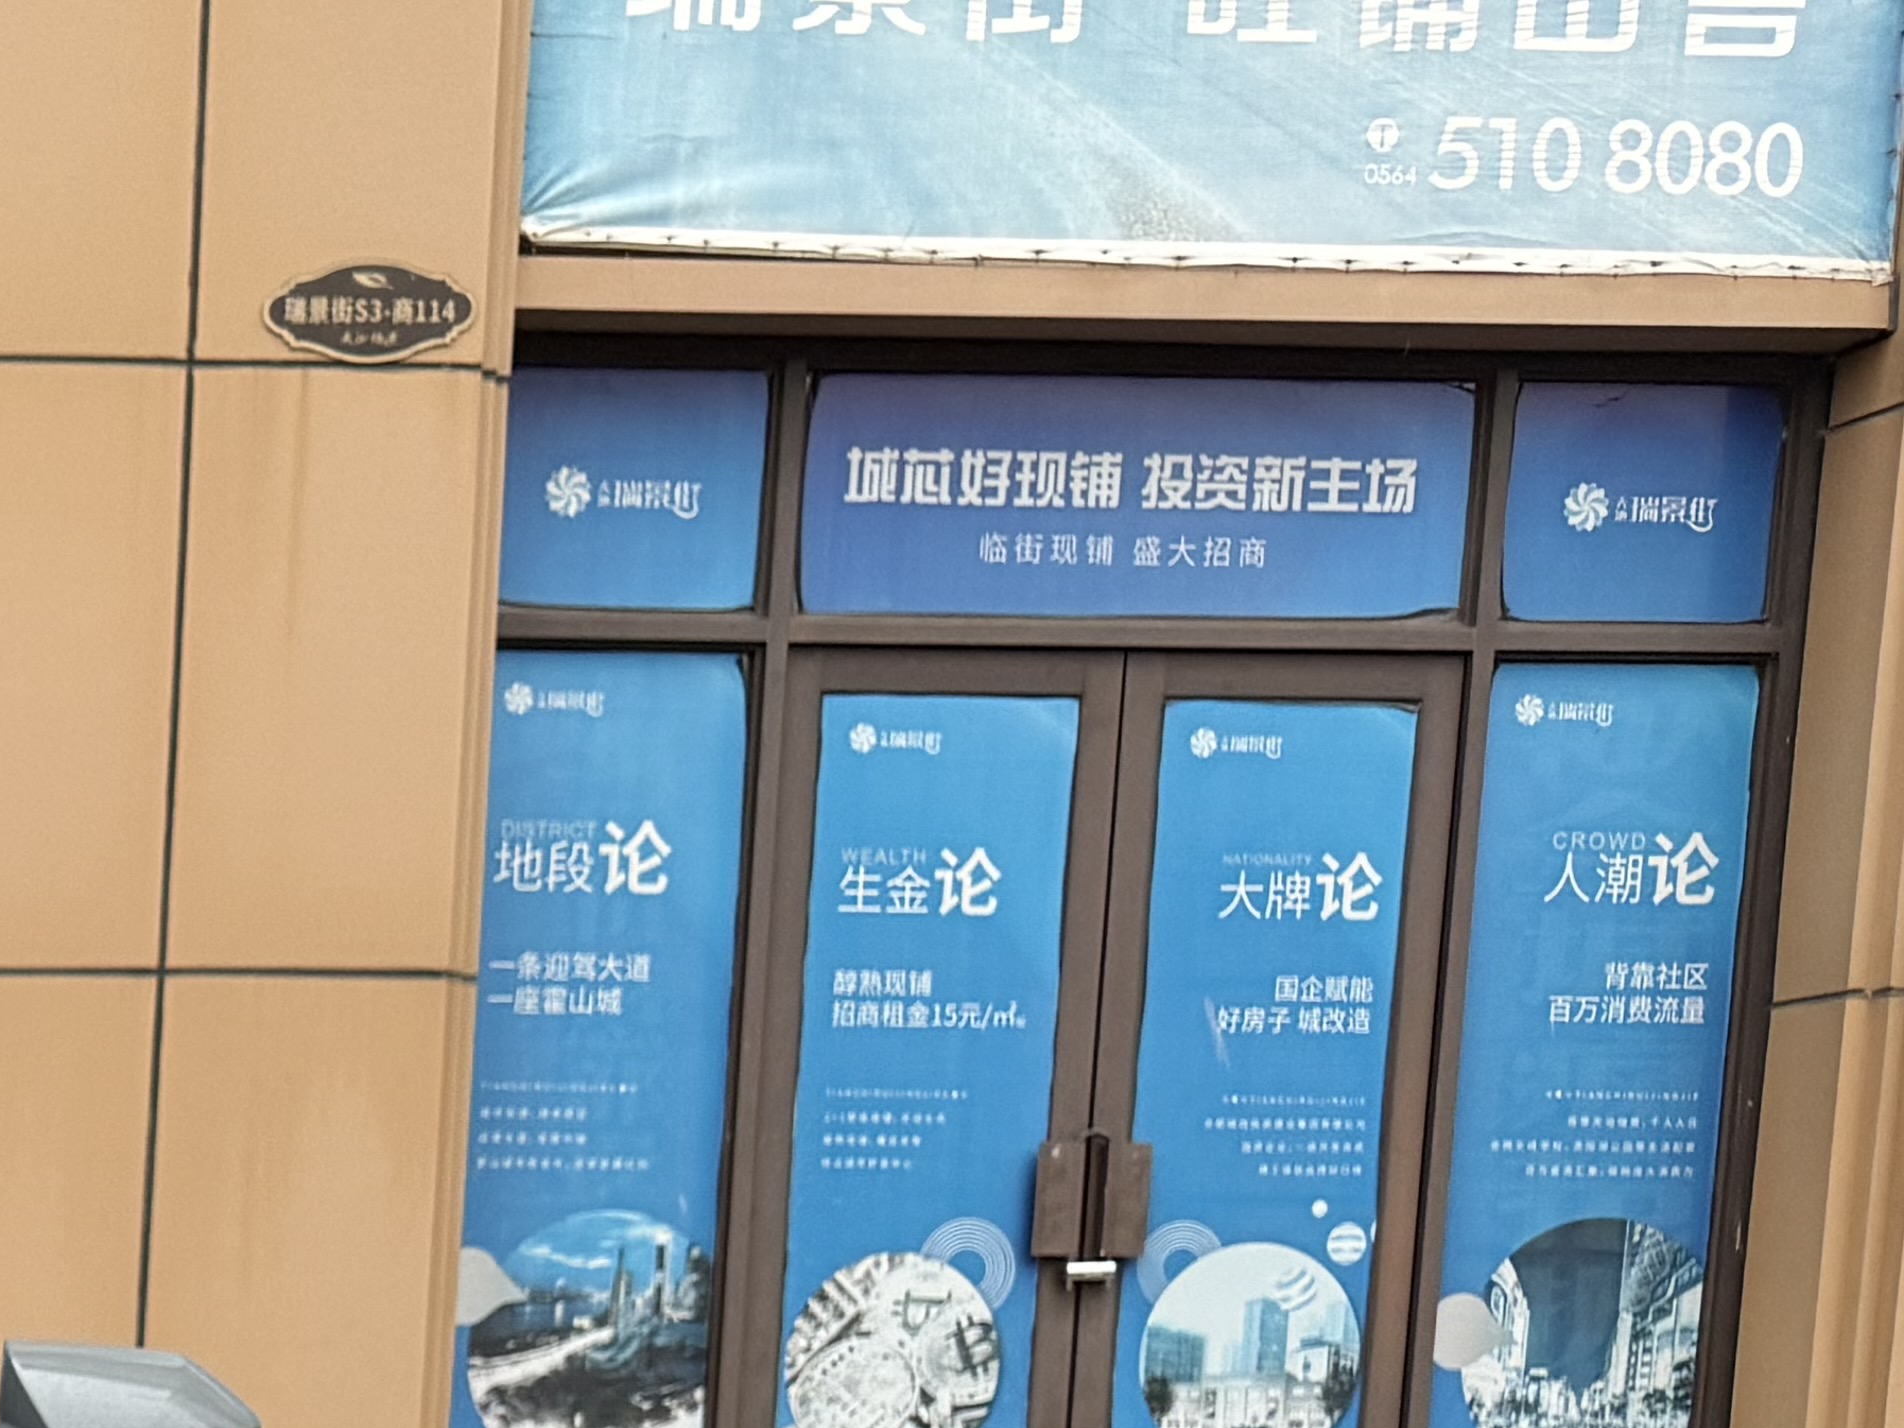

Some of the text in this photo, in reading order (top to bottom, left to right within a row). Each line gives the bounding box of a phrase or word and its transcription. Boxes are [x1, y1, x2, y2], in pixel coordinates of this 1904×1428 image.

[1364, 116, 1803, 198] 0564 510 8080
[845, 446, 1418, 515] 城芯好现铺 投资新主场
[979, 532, 1267, 570] 临街现铺 盛大招商
[501, 819, 597, 840] DISTRICT
[1553, 830, 1646, 851] CROWD
[493, 819, 672, 896] 地段论
[842, 847, 927, 866] WEALTH
[1223, 853, 1312, 867] NATIONALITY
[1543, 831, 1719, 907] 人潮论
[837, 846, 1002, 917] 生金论
[1218, 851, 1383, 922] 大牌论
[1274, 975, 1374, 1004] 国企赋能
[1605, 961, 1709, 991] 背靠社区
[1217, 1005, 1371, 1035] 好房子 城改造
[1548, 994, 1705, 1025] 百万消费流量
